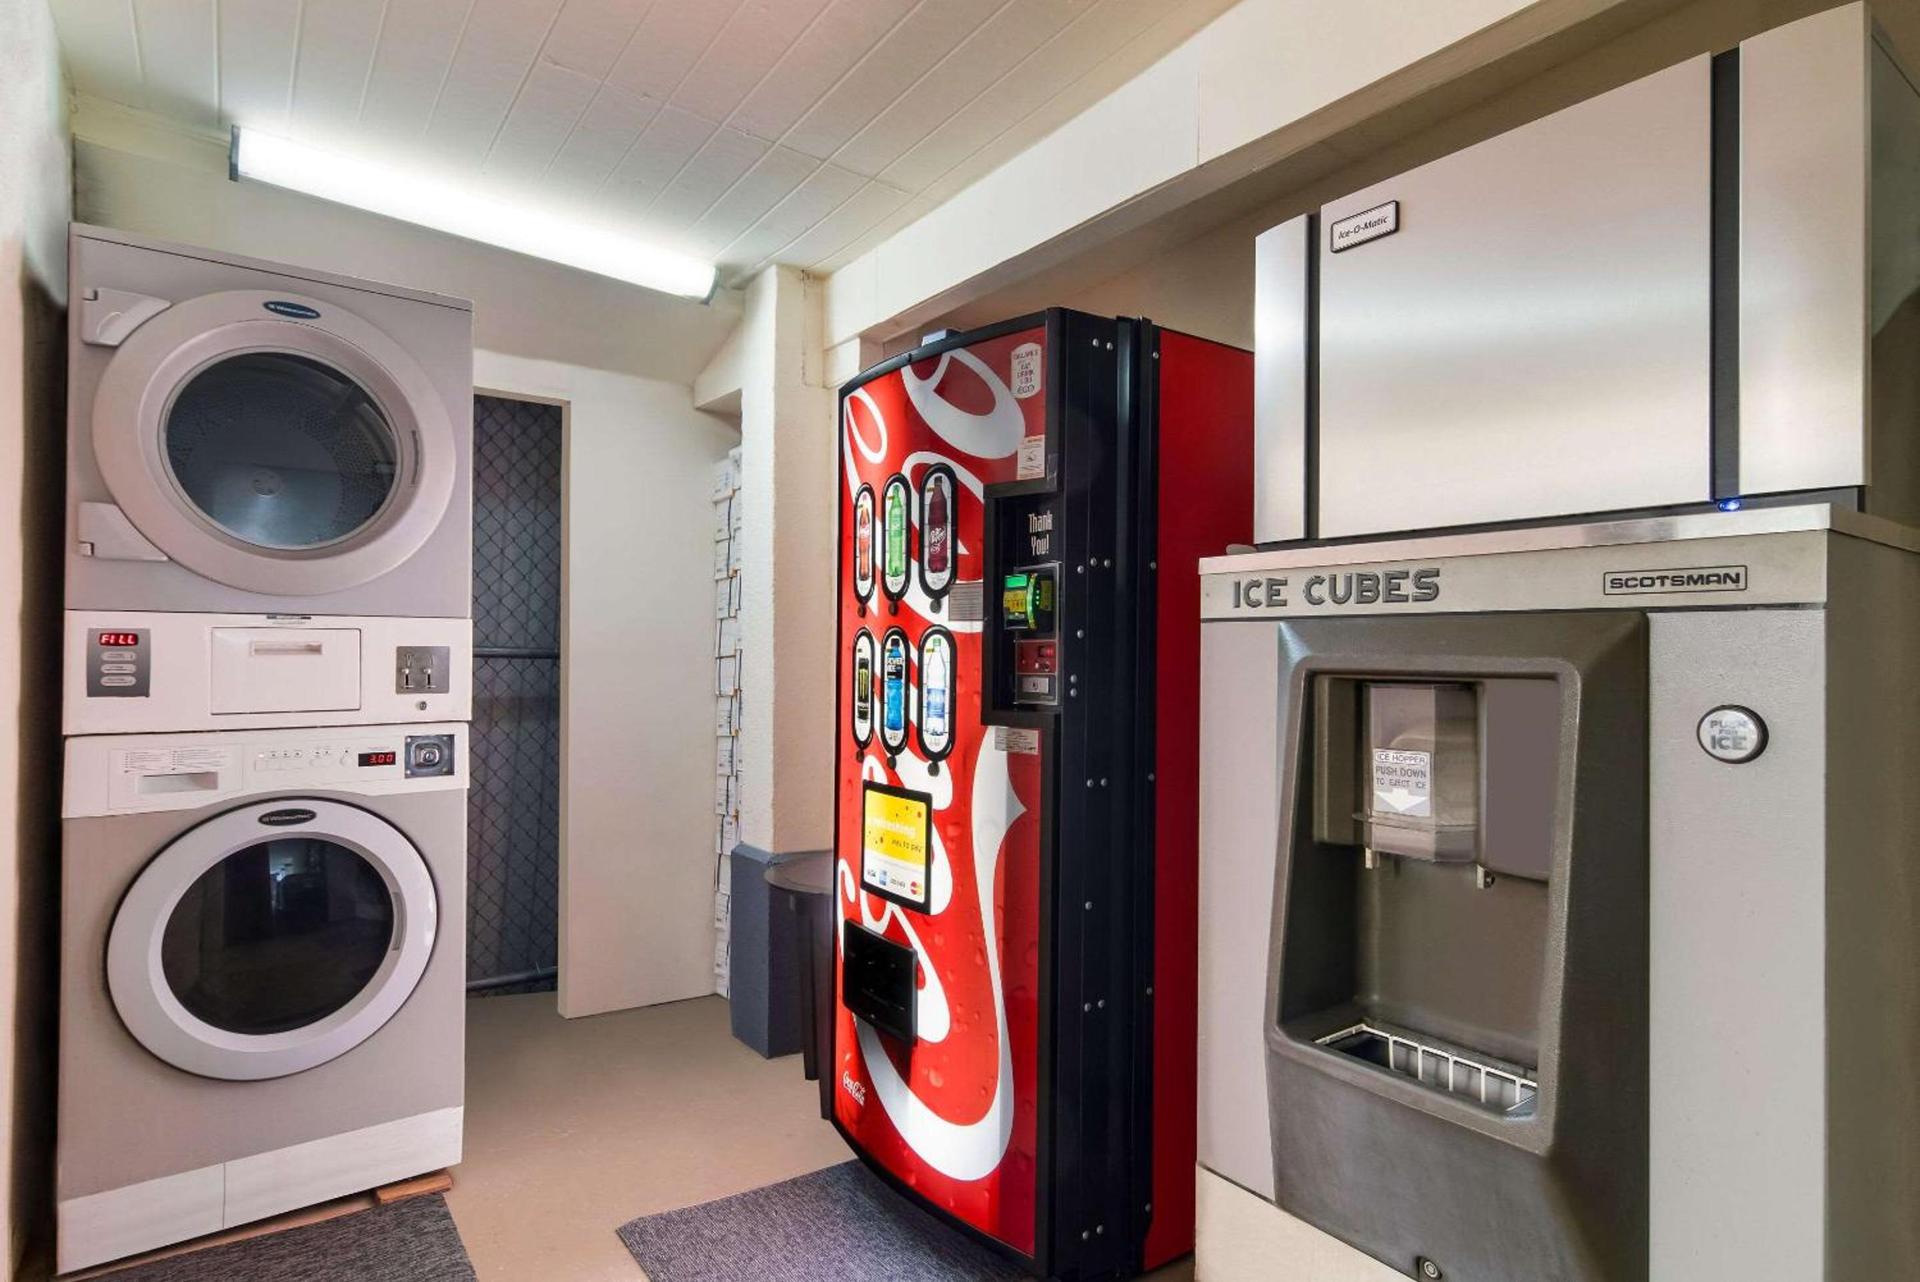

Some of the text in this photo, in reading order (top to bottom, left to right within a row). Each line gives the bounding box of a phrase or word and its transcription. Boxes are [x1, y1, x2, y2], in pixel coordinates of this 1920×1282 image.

[1338, 216, 1388, 239] Ice-O-Matic
[1028, 510, 1053, 533] Thank
[1031, 534, 1049, 556] You!
[1233, 568, 1440, 608] ICE CUBES
[1609, 572, 1741, 589] SCOTSMAN
[101, 634, 136, 645] FILL
[1711, 735, 1747, 750] ICE
[1376, 766, 1426, 778] PUSH DOWN
[1376, 777, 1385, 786] TO
